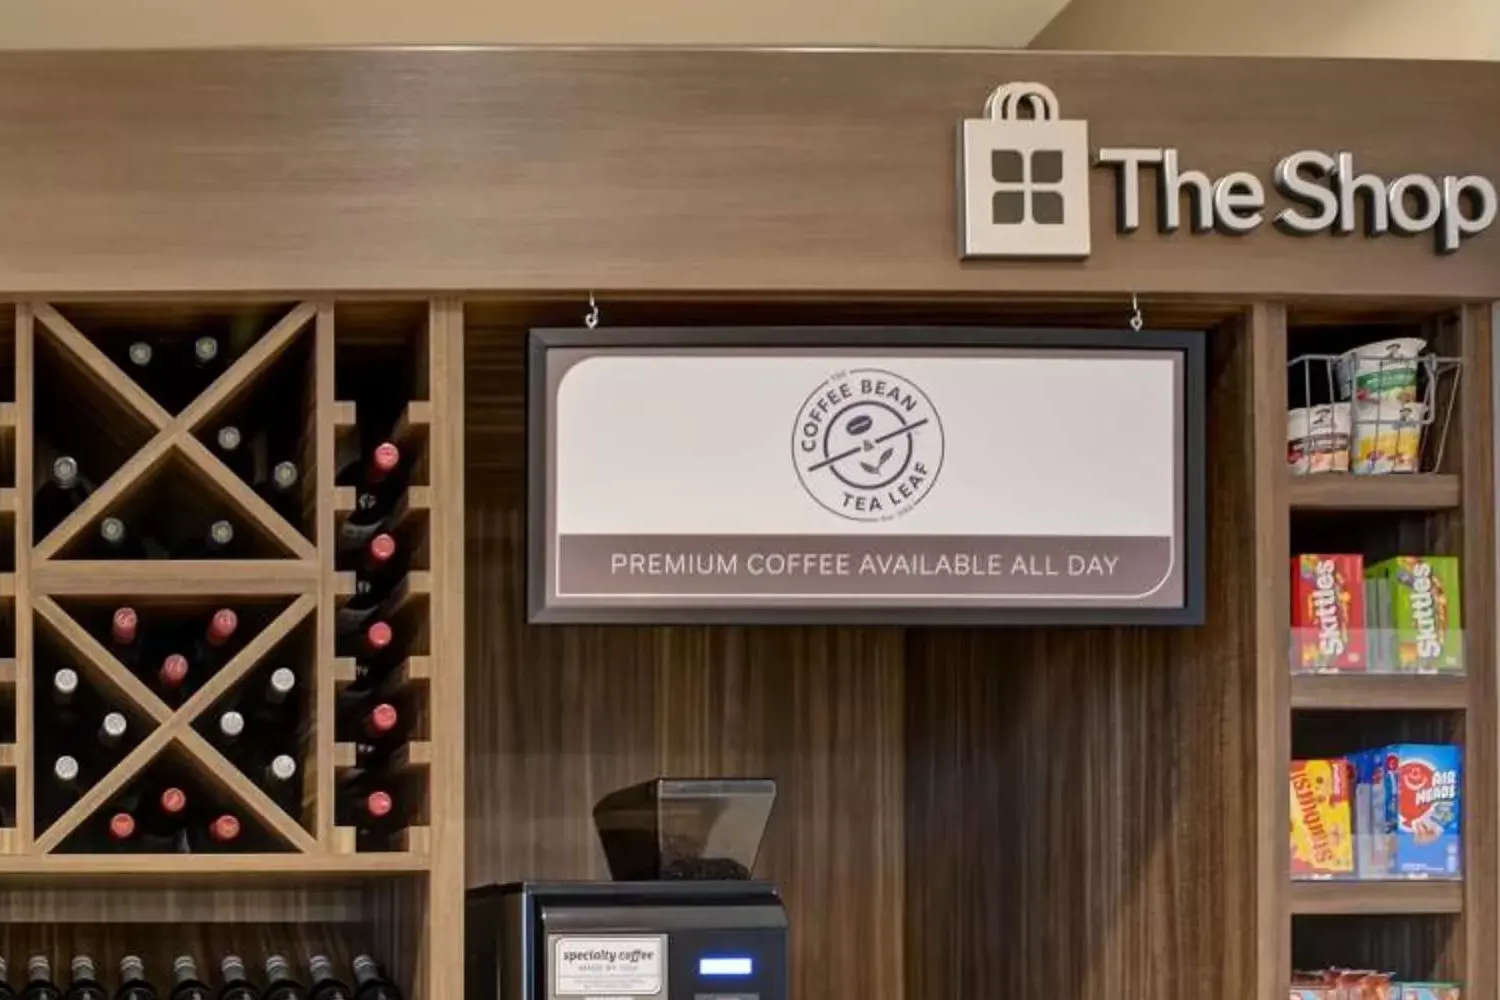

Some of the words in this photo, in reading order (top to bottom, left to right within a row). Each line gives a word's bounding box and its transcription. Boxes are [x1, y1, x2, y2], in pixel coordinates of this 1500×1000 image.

[1096, 147, 1266, 234] The
[1274, 149, 1499, 253] Shop
[801, 382, 853, 453] COFFEE
[860, 379, 918, 412] BEAN
[843, 491, 883, 512] TEA
[887, 461, 928, 506] LEAF
[611, 553, 738, 576] PREMIUM
[747, 553, 850, 576] COFFEE
[858, 554, 1002, 577] AVAILABLE
[1011, 554, 1059, 577] ALL
[1068, 554, 1119, 577] DAY
[1312, 559, 1345, 657] Skittles
[1410, 562, 1441, 658] Skittles
[563, 949, 617, 963] specialty
[618, 948, 654, 963] coffee
